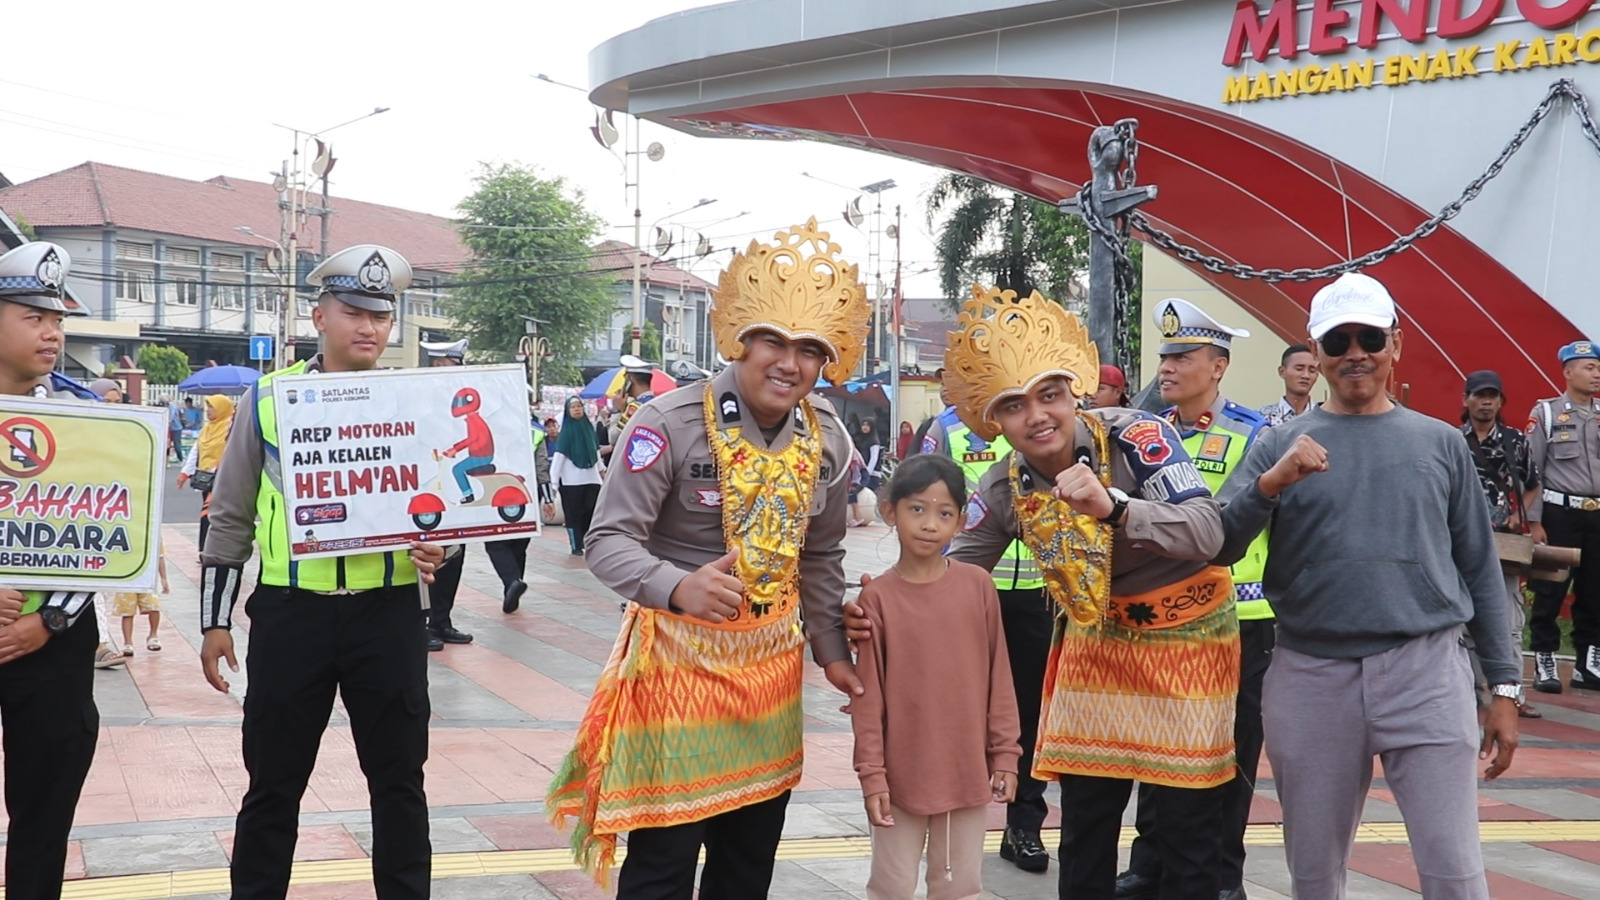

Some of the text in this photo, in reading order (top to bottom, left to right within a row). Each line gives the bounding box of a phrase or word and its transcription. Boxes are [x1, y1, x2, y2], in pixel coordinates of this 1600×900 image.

[1221, 58, 1375, 104] MANGAN
[1382, 44, 1481, 86] ENAK
[321, 387, 370, 397] SATLANTAS
[290, 421, 415, 444] AREP MOTORAN
[292, 445, 392, 467] AJA KELALEN
[965, 453, 993, 462] AGUS
[1194, 460, 1221, 471] POLRI
[295, 464, 419, 499] HELM'AN
[0, 480, 129, 521] BAHAYA
[0, 553, 107, 569] BERMAIN HP
